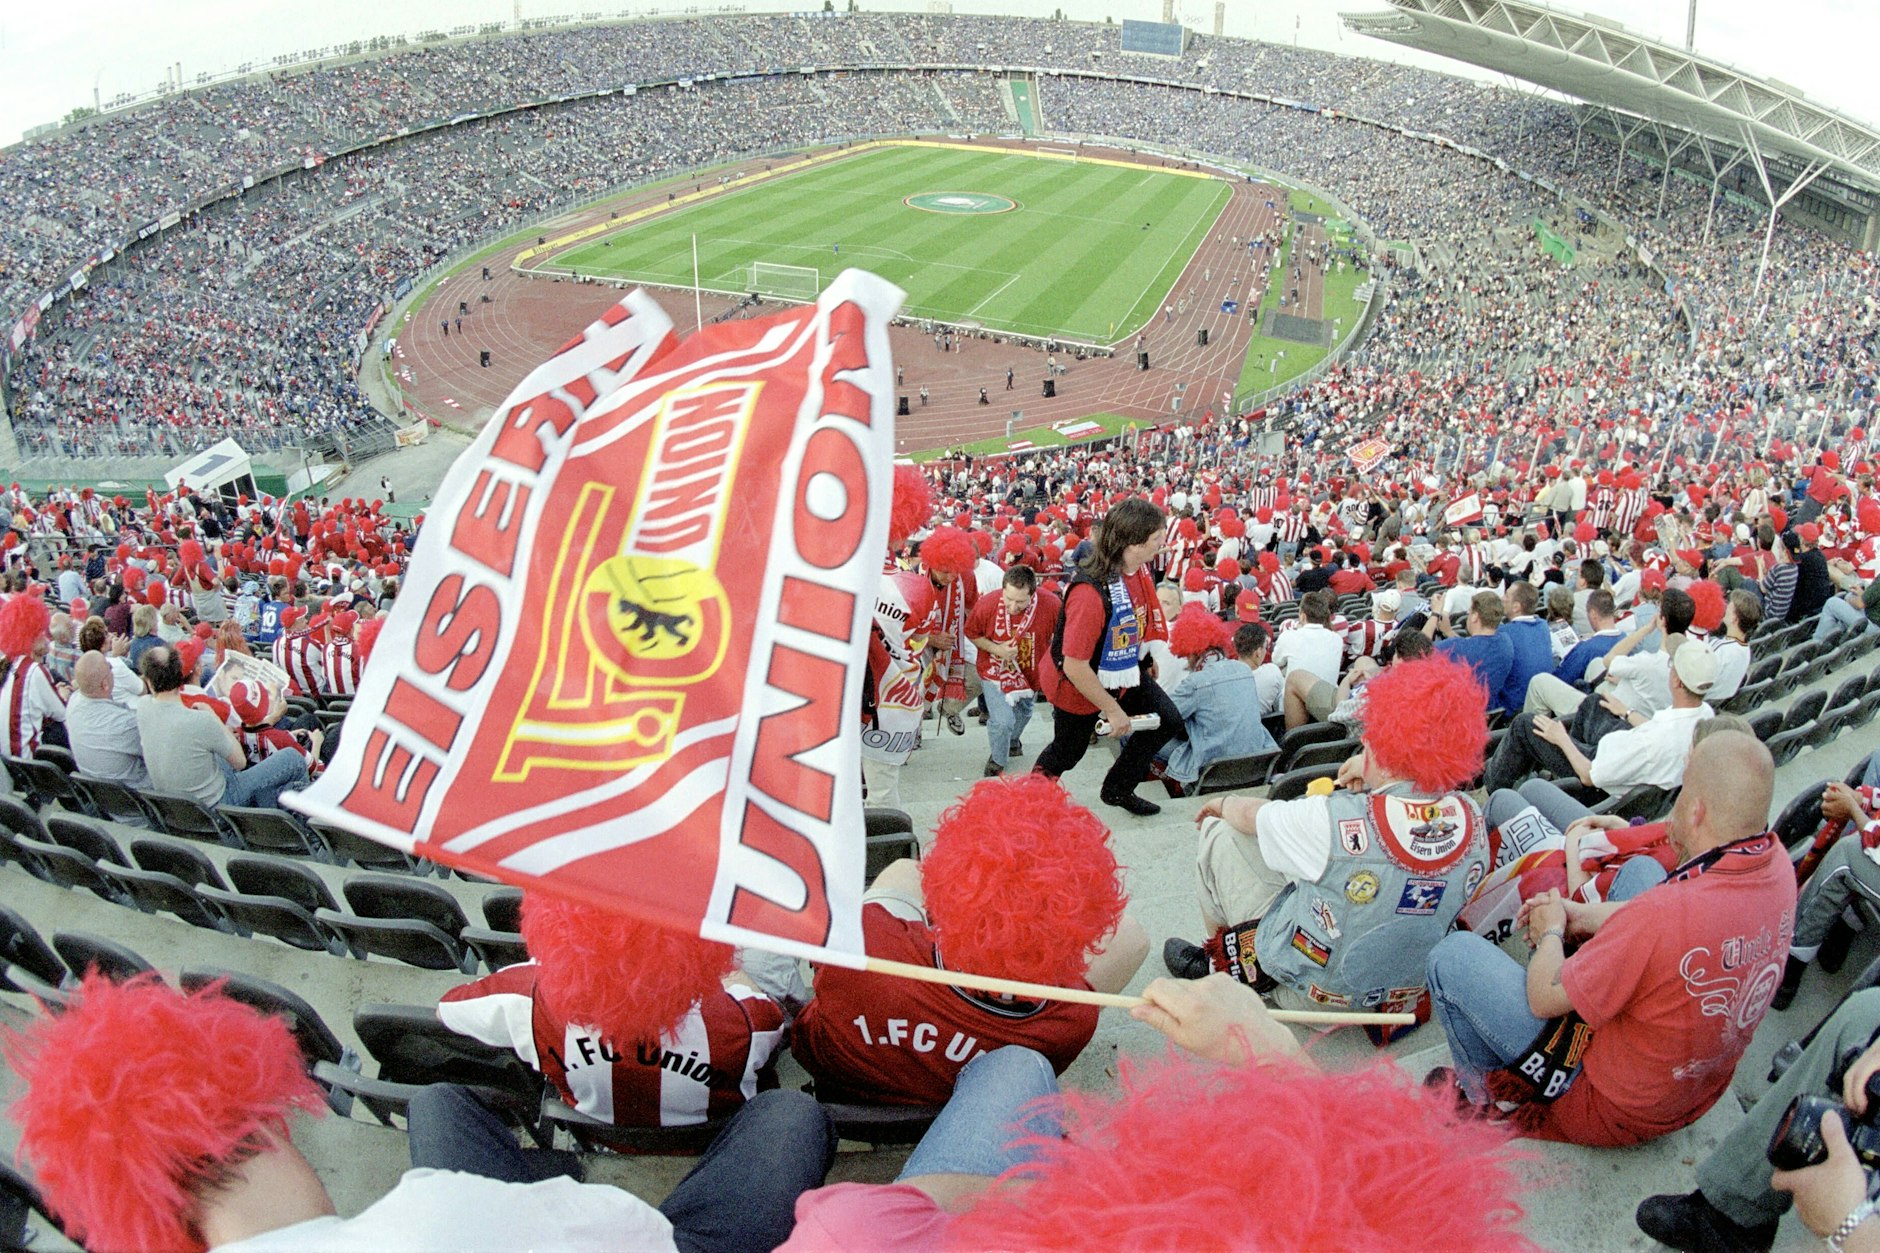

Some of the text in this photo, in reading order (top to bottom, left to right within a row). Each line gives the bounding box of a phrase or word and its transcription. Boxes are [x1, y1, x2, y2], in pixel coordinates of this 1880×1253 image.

[190, 454, 234, 477] 1
[633, 387, 750, 554] UNION
[262, 611, 277, 628] 10
[875, 597, 911, 624] nion
[1410, 838, 1457, 857] Eisern Union
[852, 1014, 939, 1053] 1.FC
